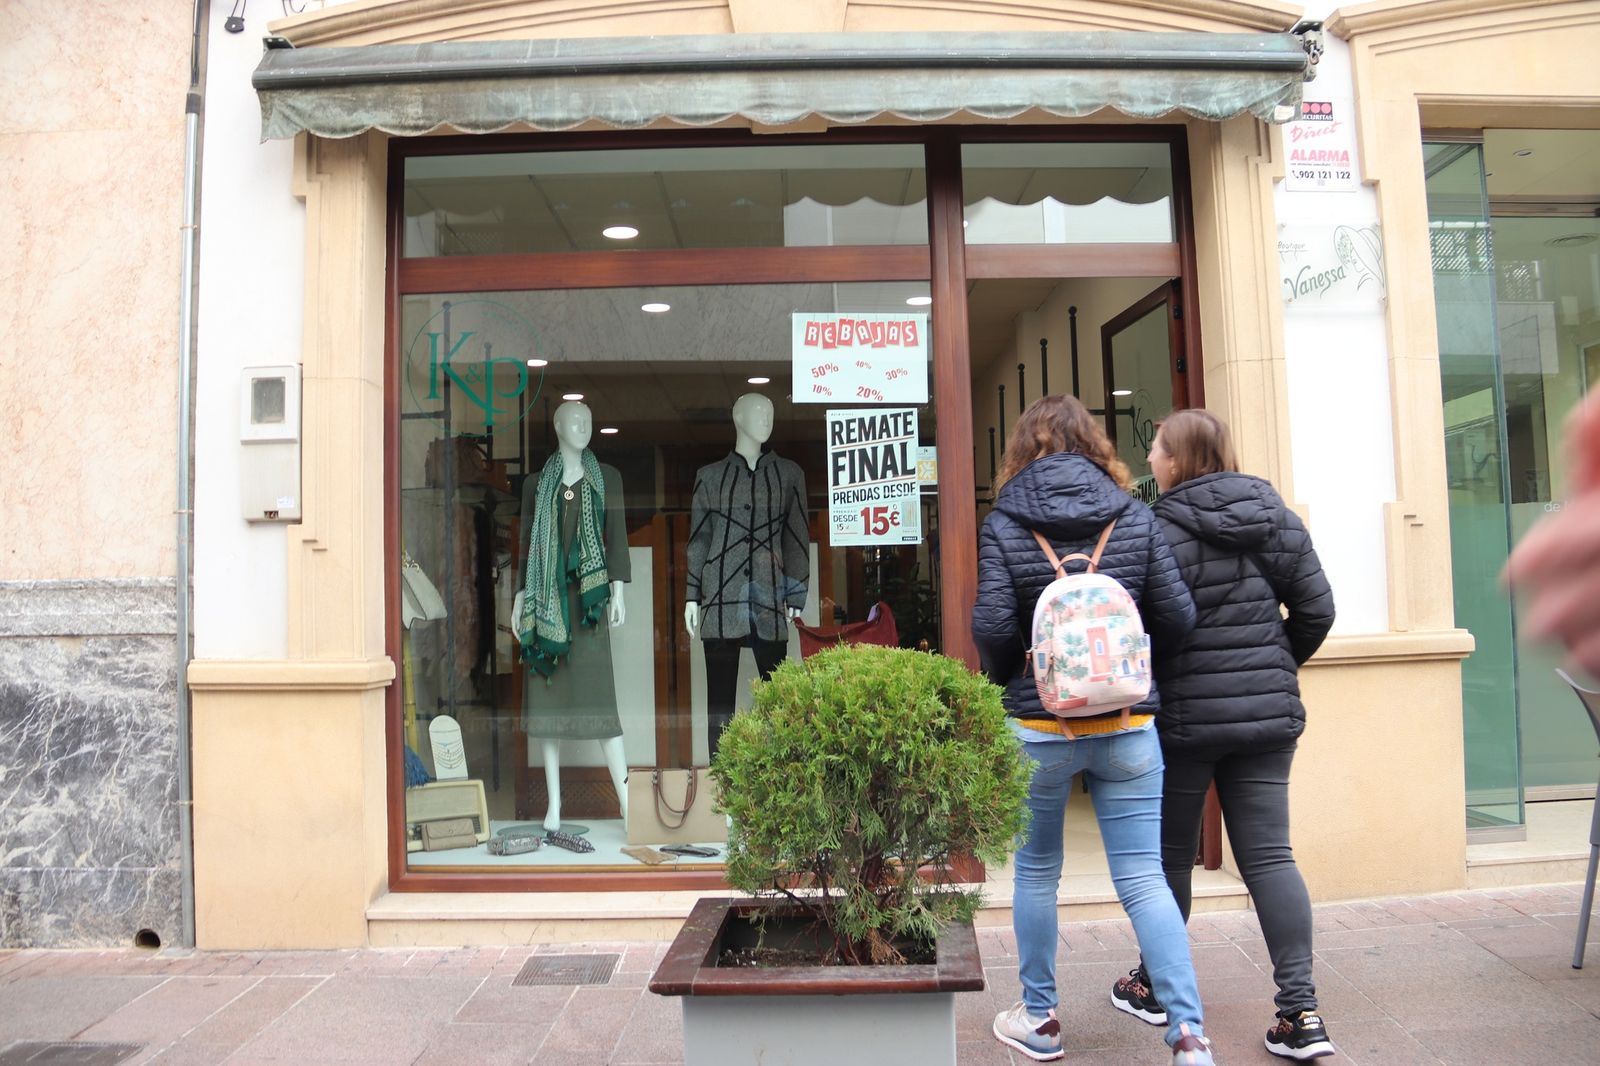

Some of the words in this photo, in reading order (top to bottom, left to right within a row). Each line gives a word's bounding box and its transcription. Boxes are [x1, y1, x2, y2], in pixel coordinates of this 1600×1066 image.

[1290, 121, 1342, 142] Direct
[1290, 149, 1350, 162] ALARMA
[1299, 170, 1315, 179] 902
[1318, 170, 1332, 180] 121
[1335, 171, 1351, 180] 122
[1284, 265, 1346, 299] Vanessa
[806, 323, 915, 344] REBAJAS
[811, 363, 839, 378] 50%
[885, 368, 908, 380] 30%
[812, 384, 832, 397] 10%
[856, 386, 883, 401] 20%
[831, 411, 914, 446] REMATE
[832, 441, 916, 487] FINAL
[833, 487, 880, 505] PRENDAS
[883, 482, 916, 498] DESDE
[833, 514, 858, 523] DESDE
[860, 506, 900, 536] 15€
